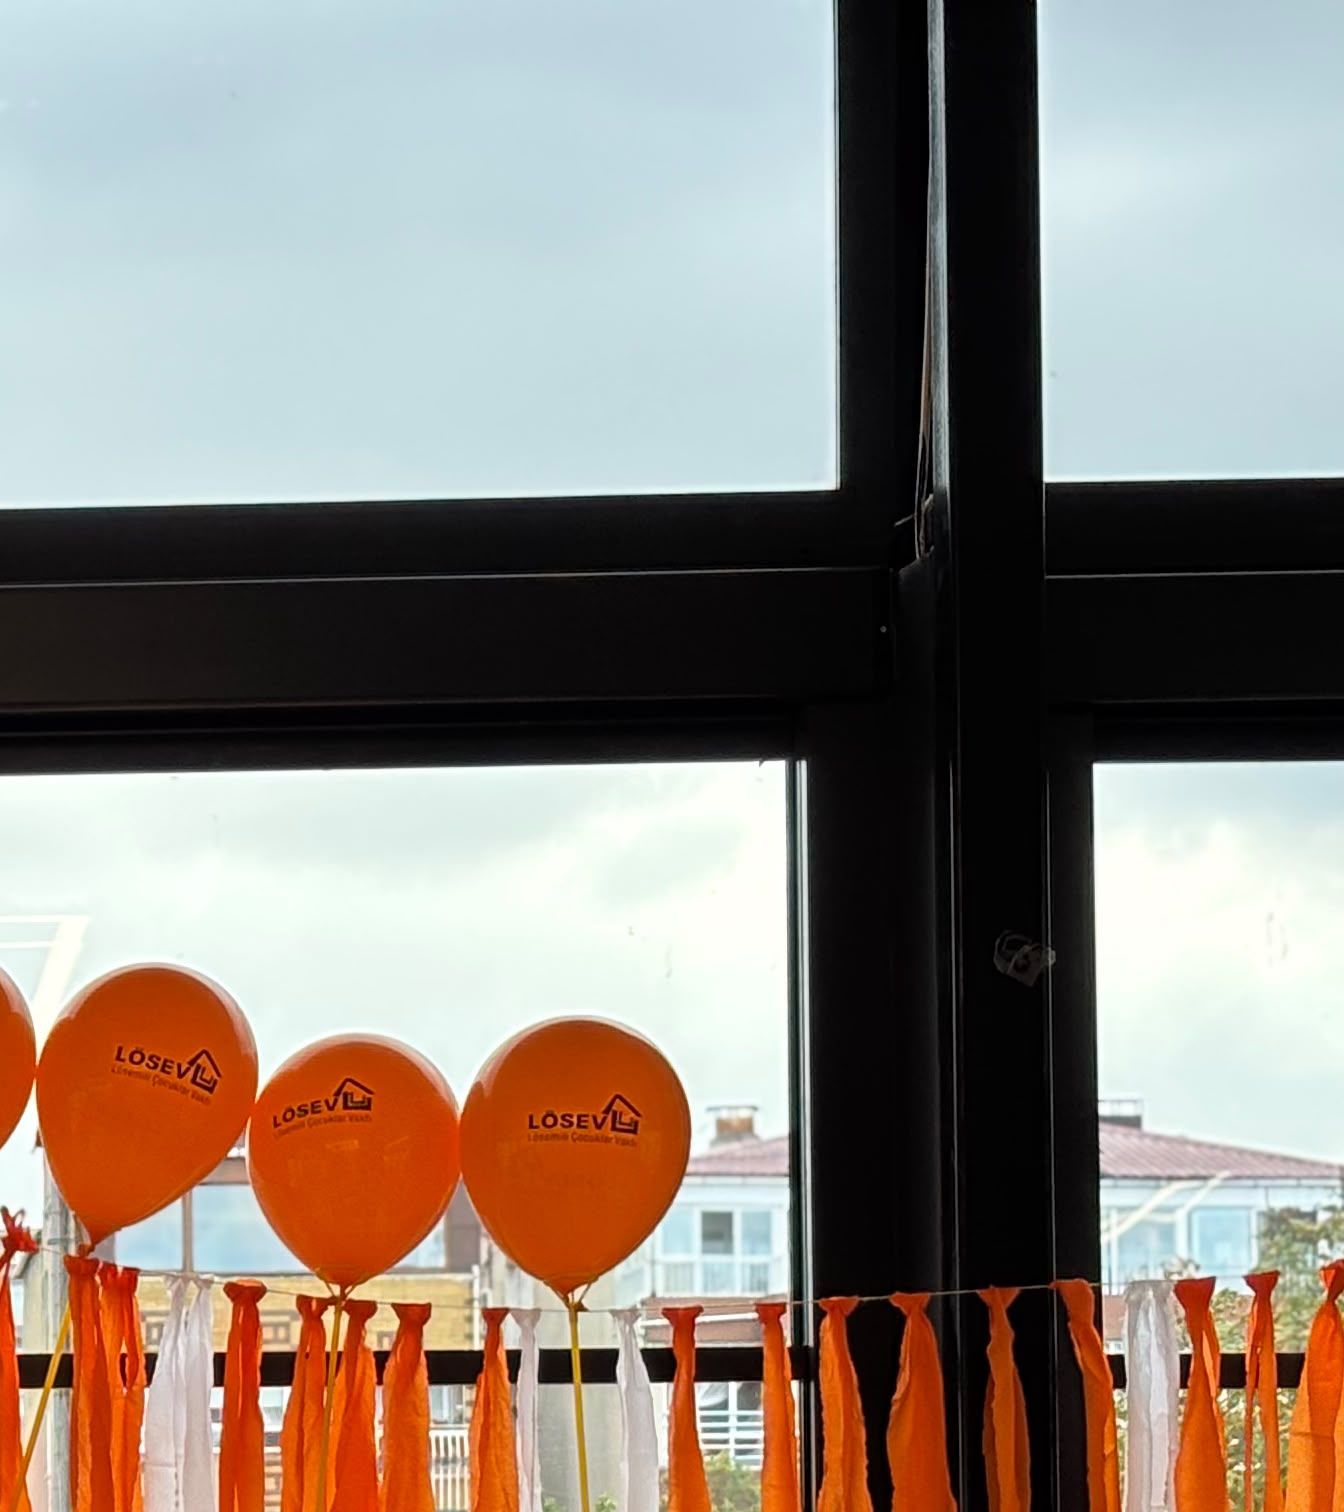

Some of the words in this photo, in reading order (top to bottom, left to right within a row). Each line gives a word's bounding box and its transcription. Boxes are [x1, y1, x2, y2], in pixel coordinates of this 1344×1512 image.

[115, 1046, 192, 1079] LÖSEV
[272, 1096, 339, 1128] LÖSEV
[528, 1109, 609, 1130] LÖSEV
